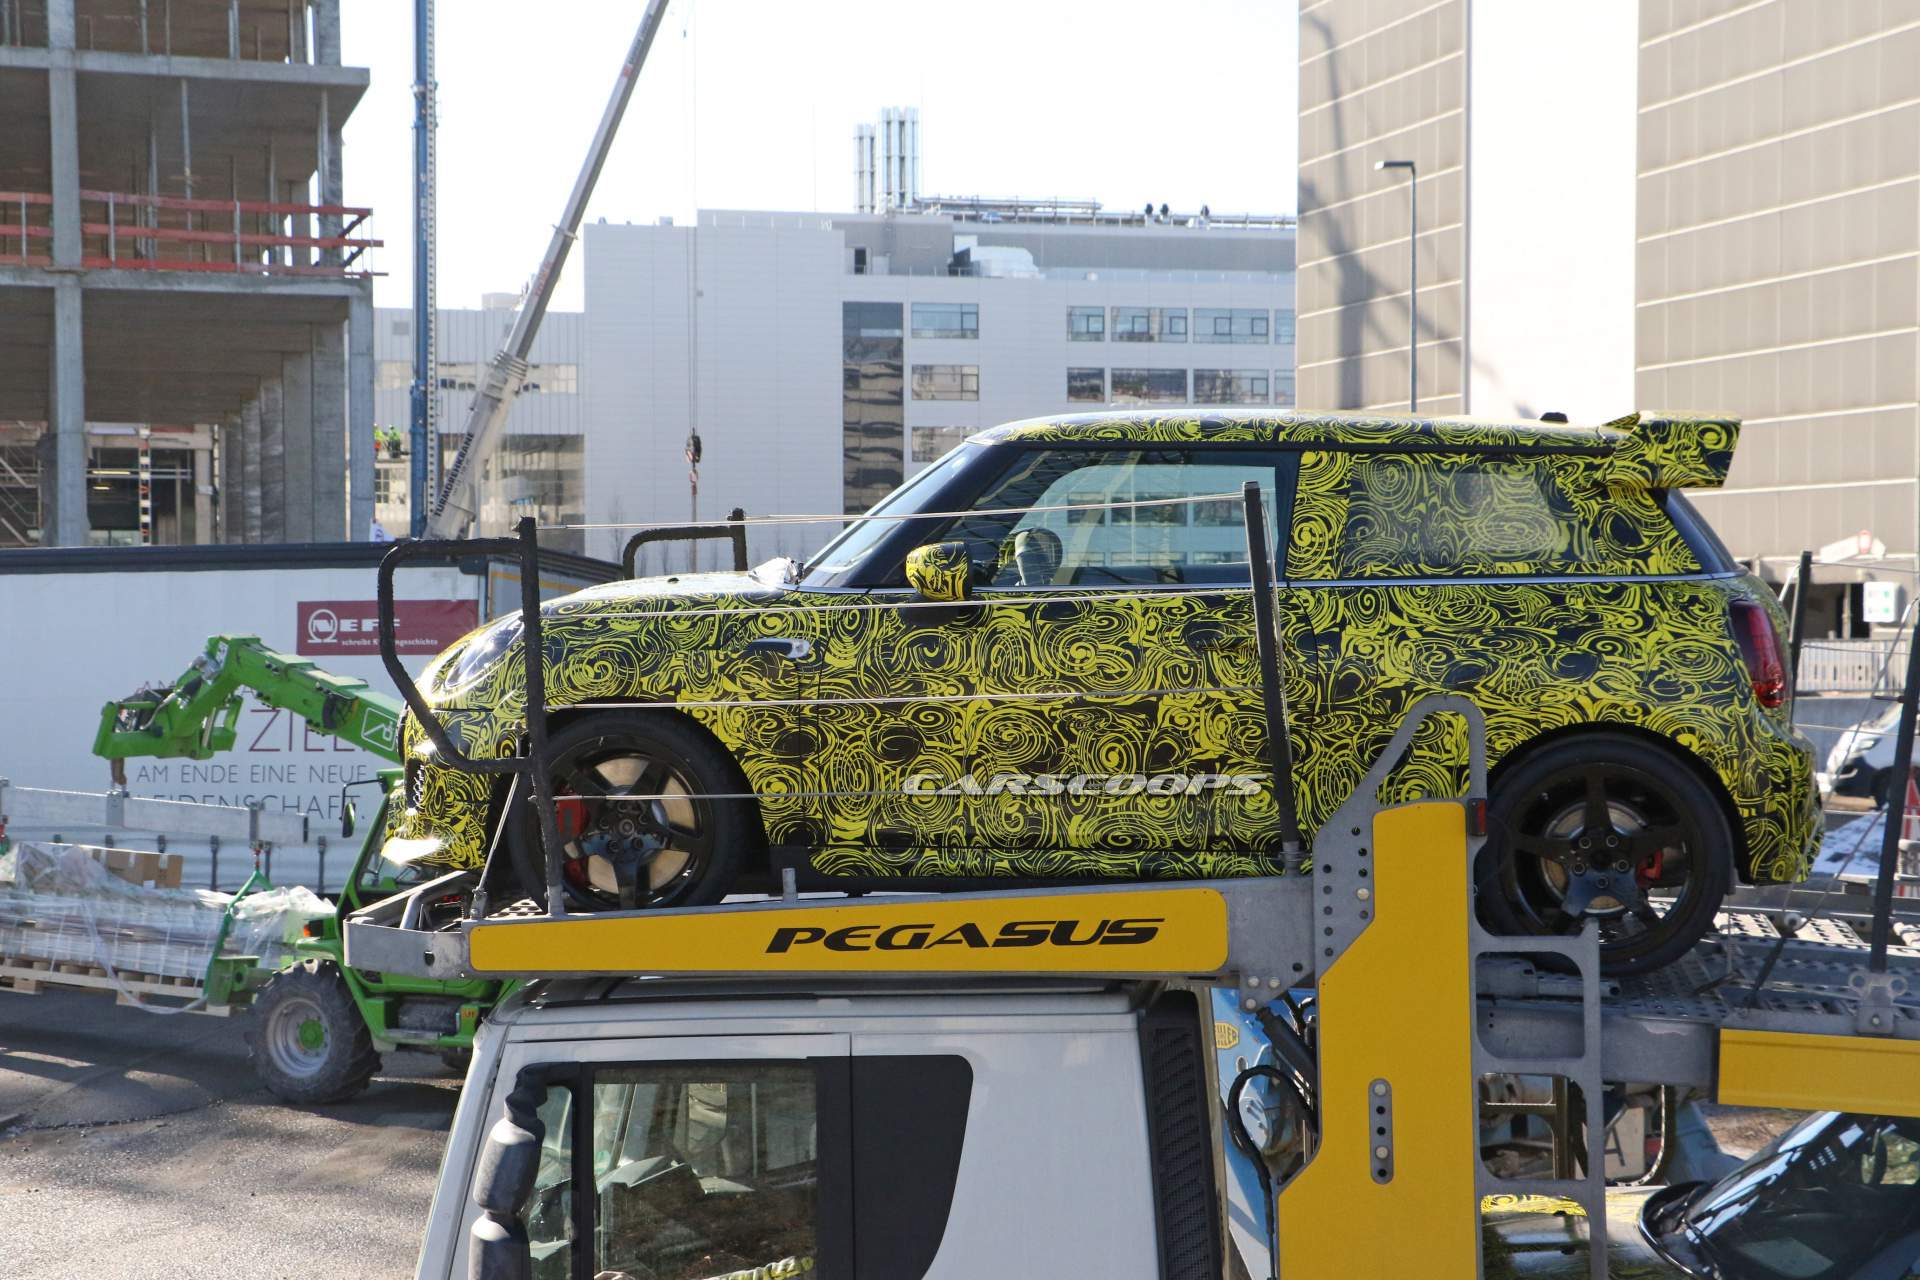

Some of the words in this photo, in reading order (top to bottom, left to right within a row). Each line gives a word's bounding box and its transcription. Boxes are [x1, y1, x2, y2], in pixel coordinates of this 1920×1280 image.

[373, 638, 438, 648] Kngeschichte
[136, 765, 168, 783] AM
[181, 765, 239, 783] ENDE
[250, 765, 296, 783] EINE
[309, 765, 367, 784] NEUE
[765, 917, 1166, 954] PEGASUS
